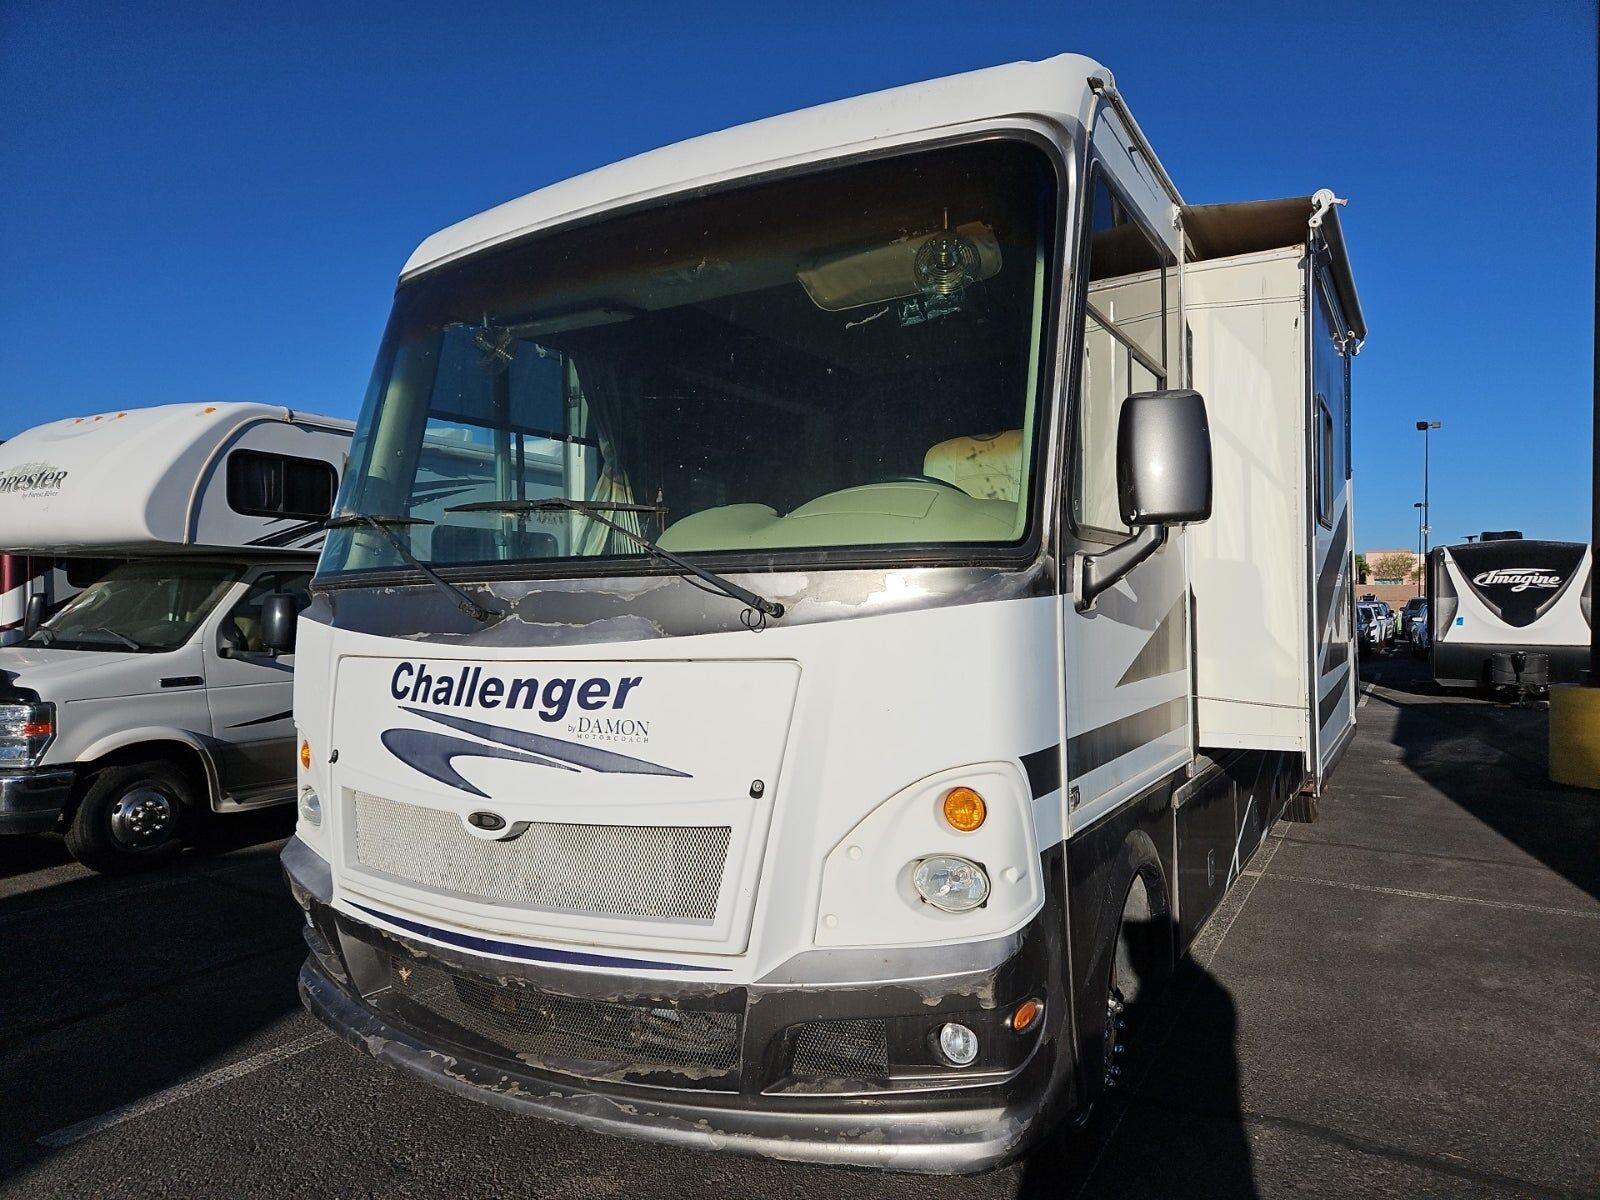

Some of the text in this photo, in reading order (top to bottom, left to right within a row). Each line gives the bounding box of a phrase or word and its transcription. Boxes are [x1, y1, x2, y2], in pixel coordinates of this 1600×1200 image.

[1482, 569, 1562, 593] Imagine
[391, 662, 643, 722] Challenger
[567, 717, 650, 736] by DAMON
[577, 734, 649, 743] MOTORCOACH
